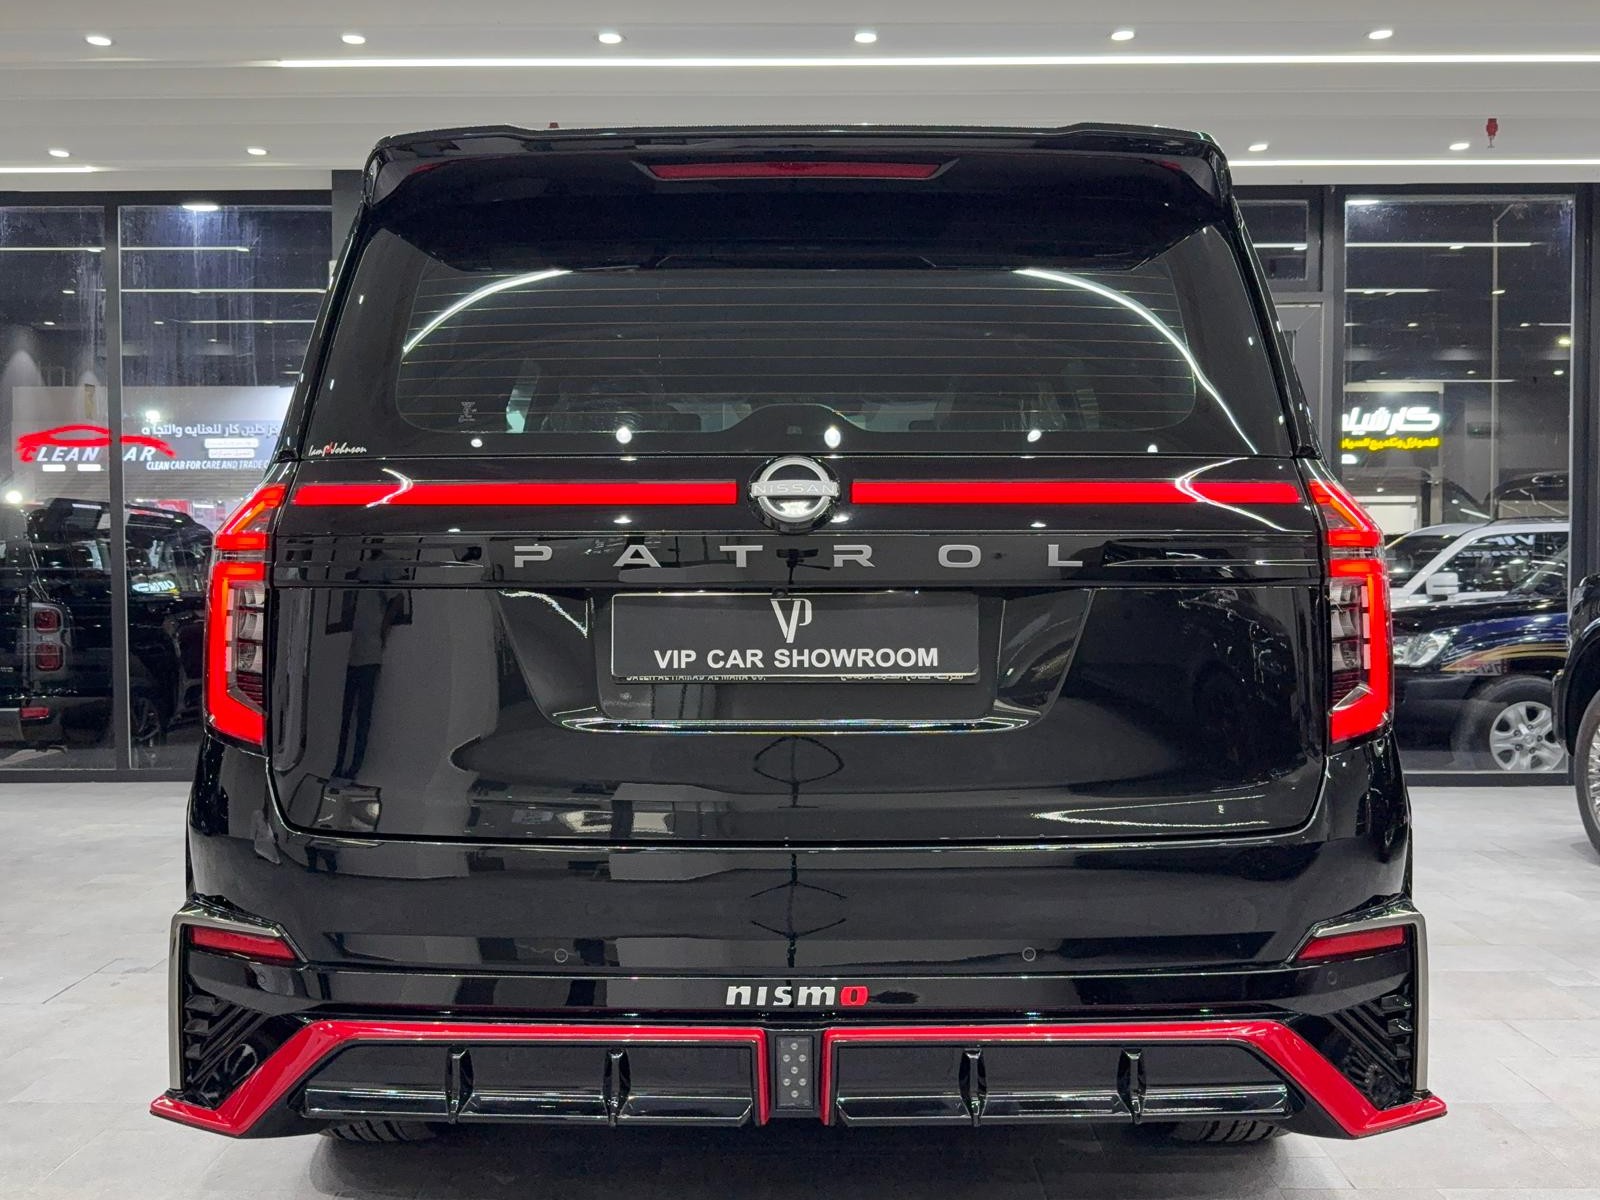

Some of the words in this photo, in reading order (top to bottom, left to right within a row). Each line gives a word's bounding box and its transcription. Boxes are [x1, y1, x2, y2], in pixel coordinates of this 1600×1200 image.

[224, 424, 240, 437] كار
[123, 446, 156, 461] AR
[146, 460, 169, 470] CLEAN
[170, 460, 185, 470] CAR
[186, 460, 201, 470] FOR
[202, 460, 221, 470] CARE
[222, 460, 238, 469] AND
[753, 483, 835, 494] NISSAN
[514, 544, 1083, 568] PATROL
[653, 649, 697, 669] VIP
[706, 649, 763, 669] CAR
[773, 647, 939, 669] SHOWROOM
[725, 985, 869, 1006] nismo
